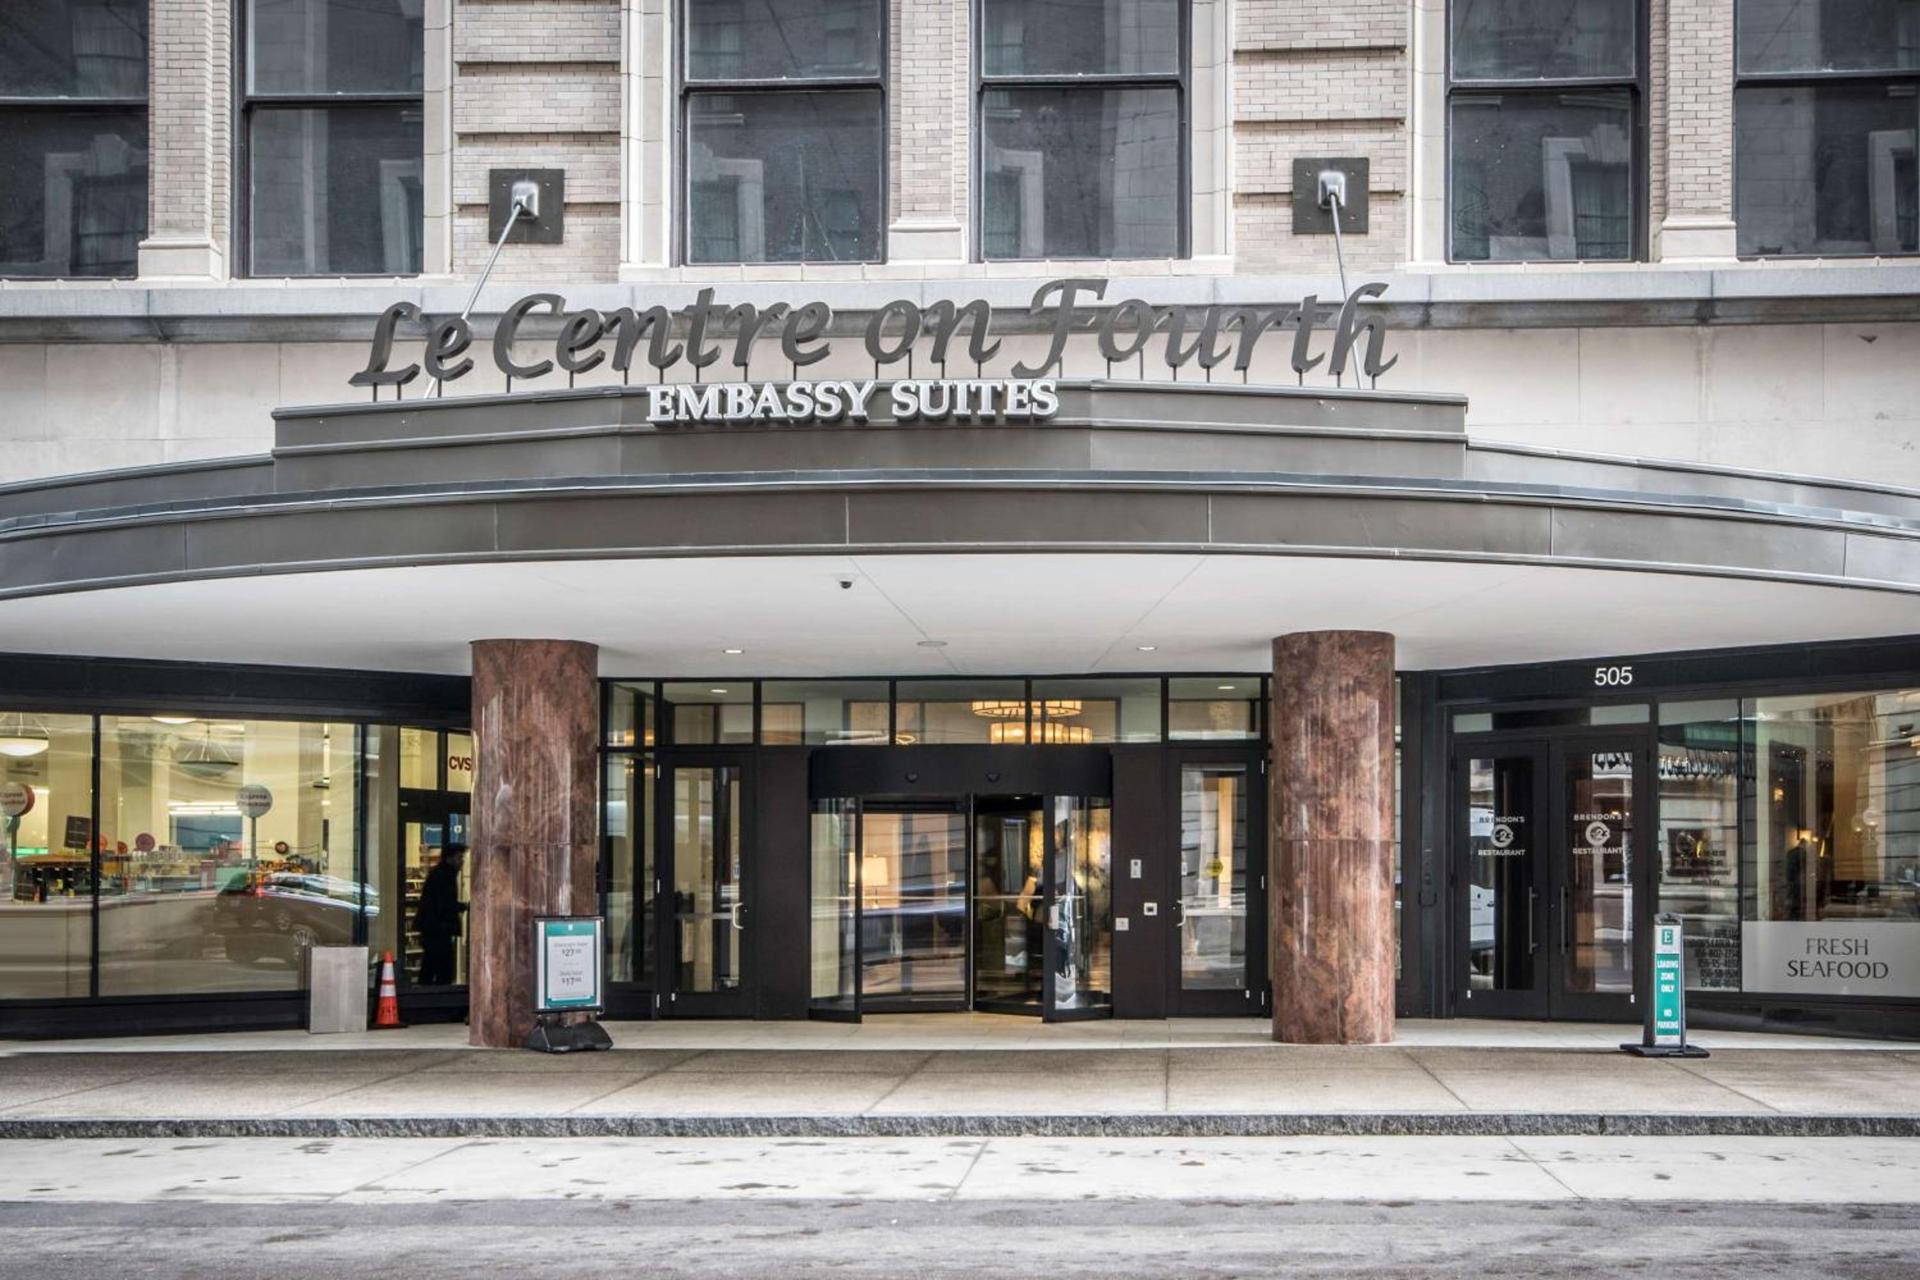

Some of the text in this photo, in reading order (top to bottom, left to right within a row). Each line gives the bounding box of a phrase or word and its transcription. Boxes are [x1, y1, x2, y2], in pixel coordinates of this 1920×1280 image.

[348, 279, 1399, 387] Le Centre on Fourth
[646, 379, 1059, 426] EMBASSY SUITES
[1594, 666, 1633, 686] 505
[449, 756, 472, 772] CVS
[1573, 813, 1623, 821] BRENDON'S
[1572, 847, 1624, 855] RESTAURANT
[1805, 937, 1869, 956] FRESH
[1787, 959, 1889, 979] SEAFOOD
